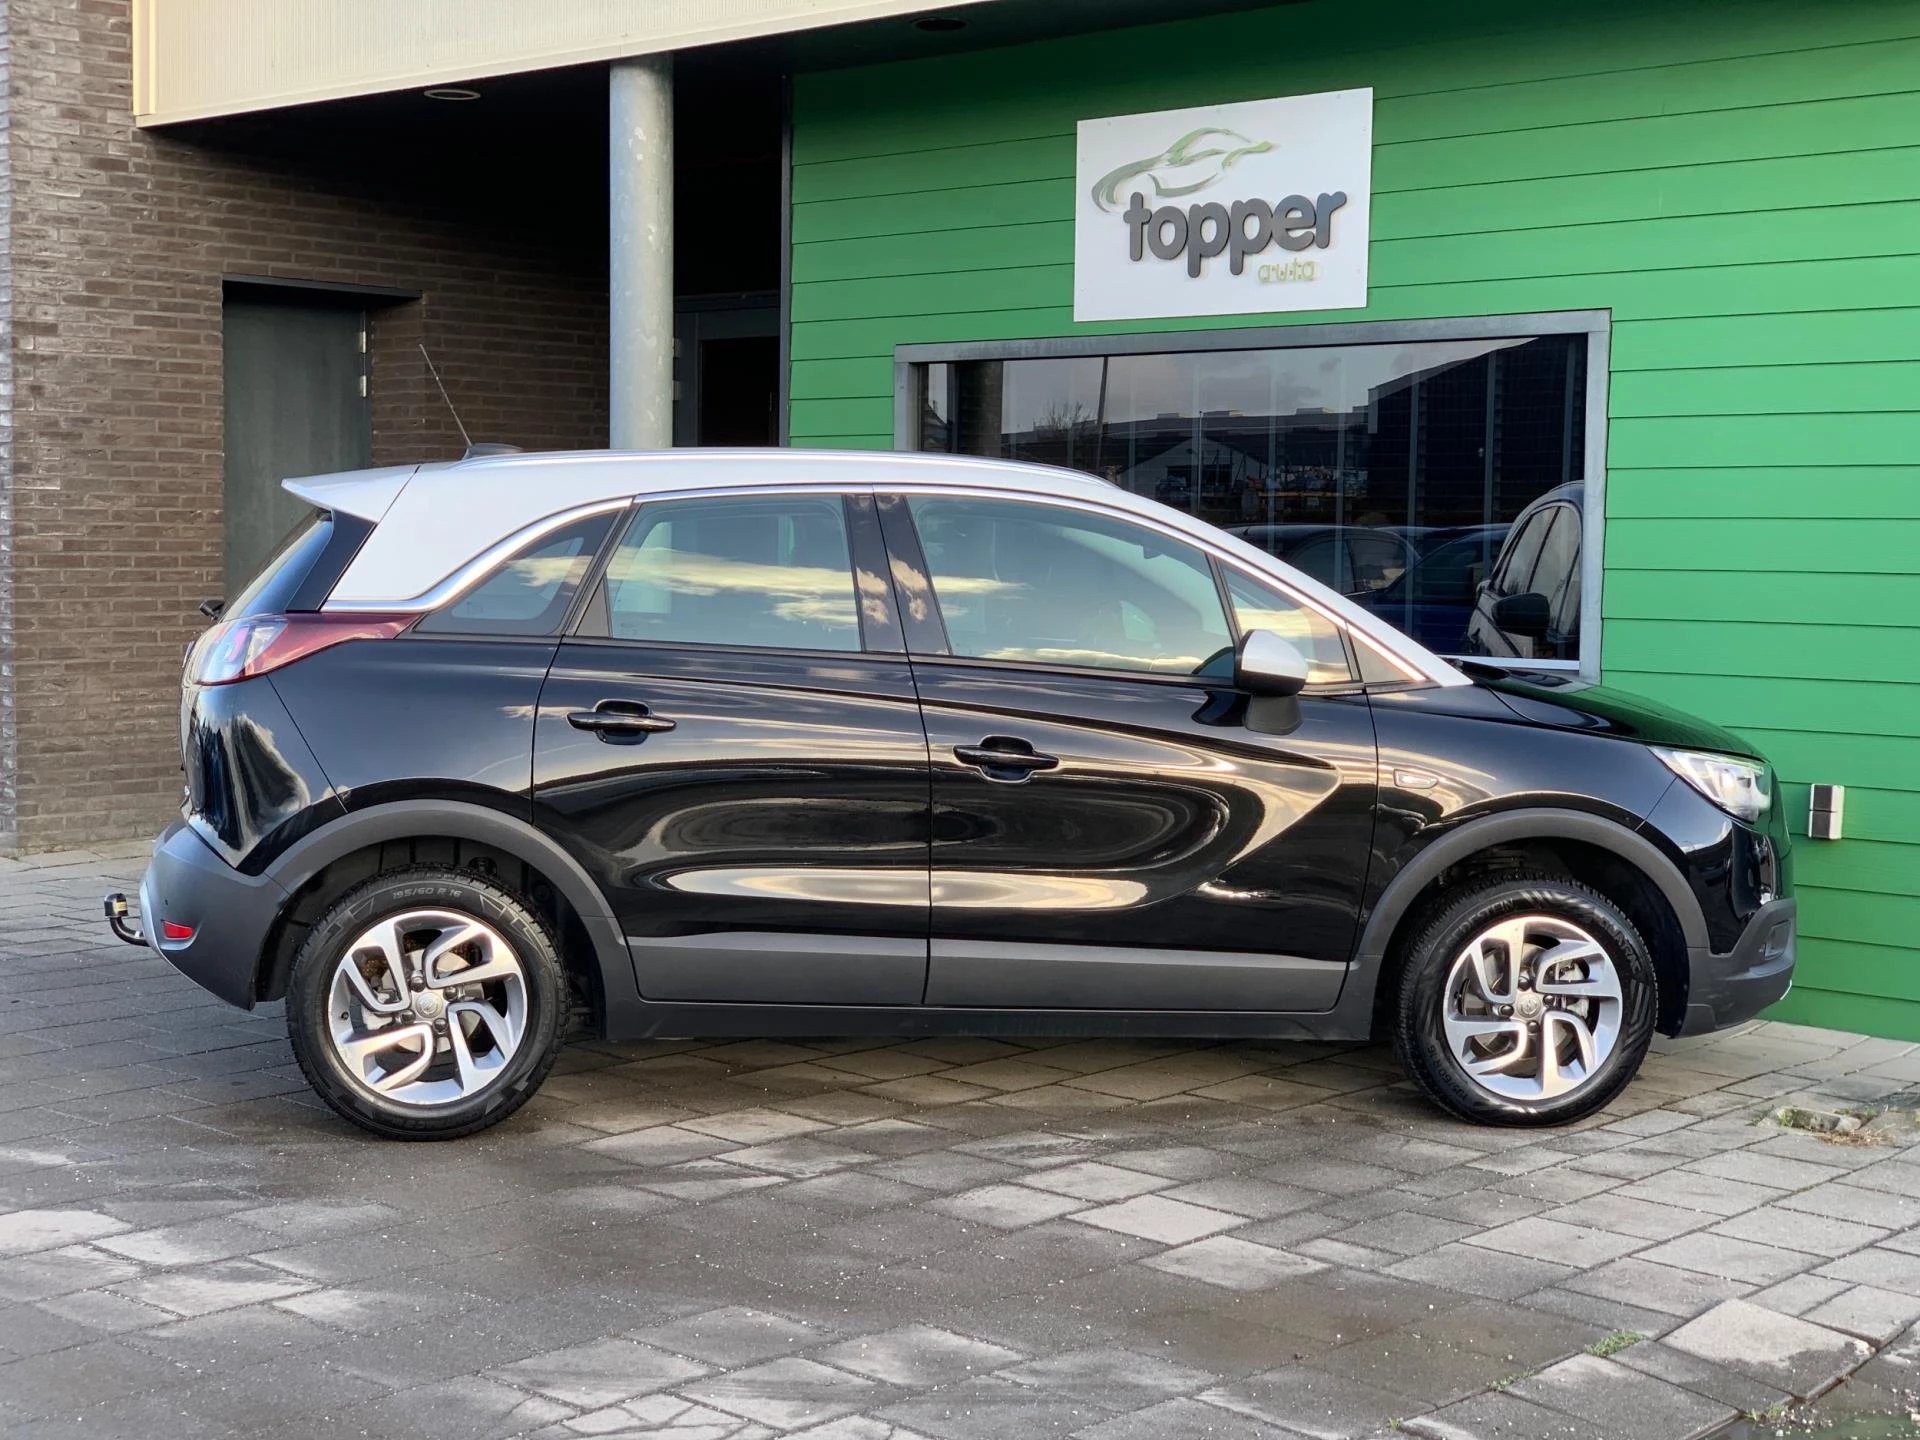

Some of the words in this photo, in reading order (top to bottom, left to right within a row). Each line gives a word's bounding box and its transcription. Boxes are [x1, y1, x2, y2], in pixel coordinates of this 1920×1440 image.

[1123, 191, 1348, 279] topper
[1258, 257, 1316, 283] auto
[393, 887, 434, 899] 195/60
[437, 887, 447, 896] R
[450, 889, 462, 898] 16
